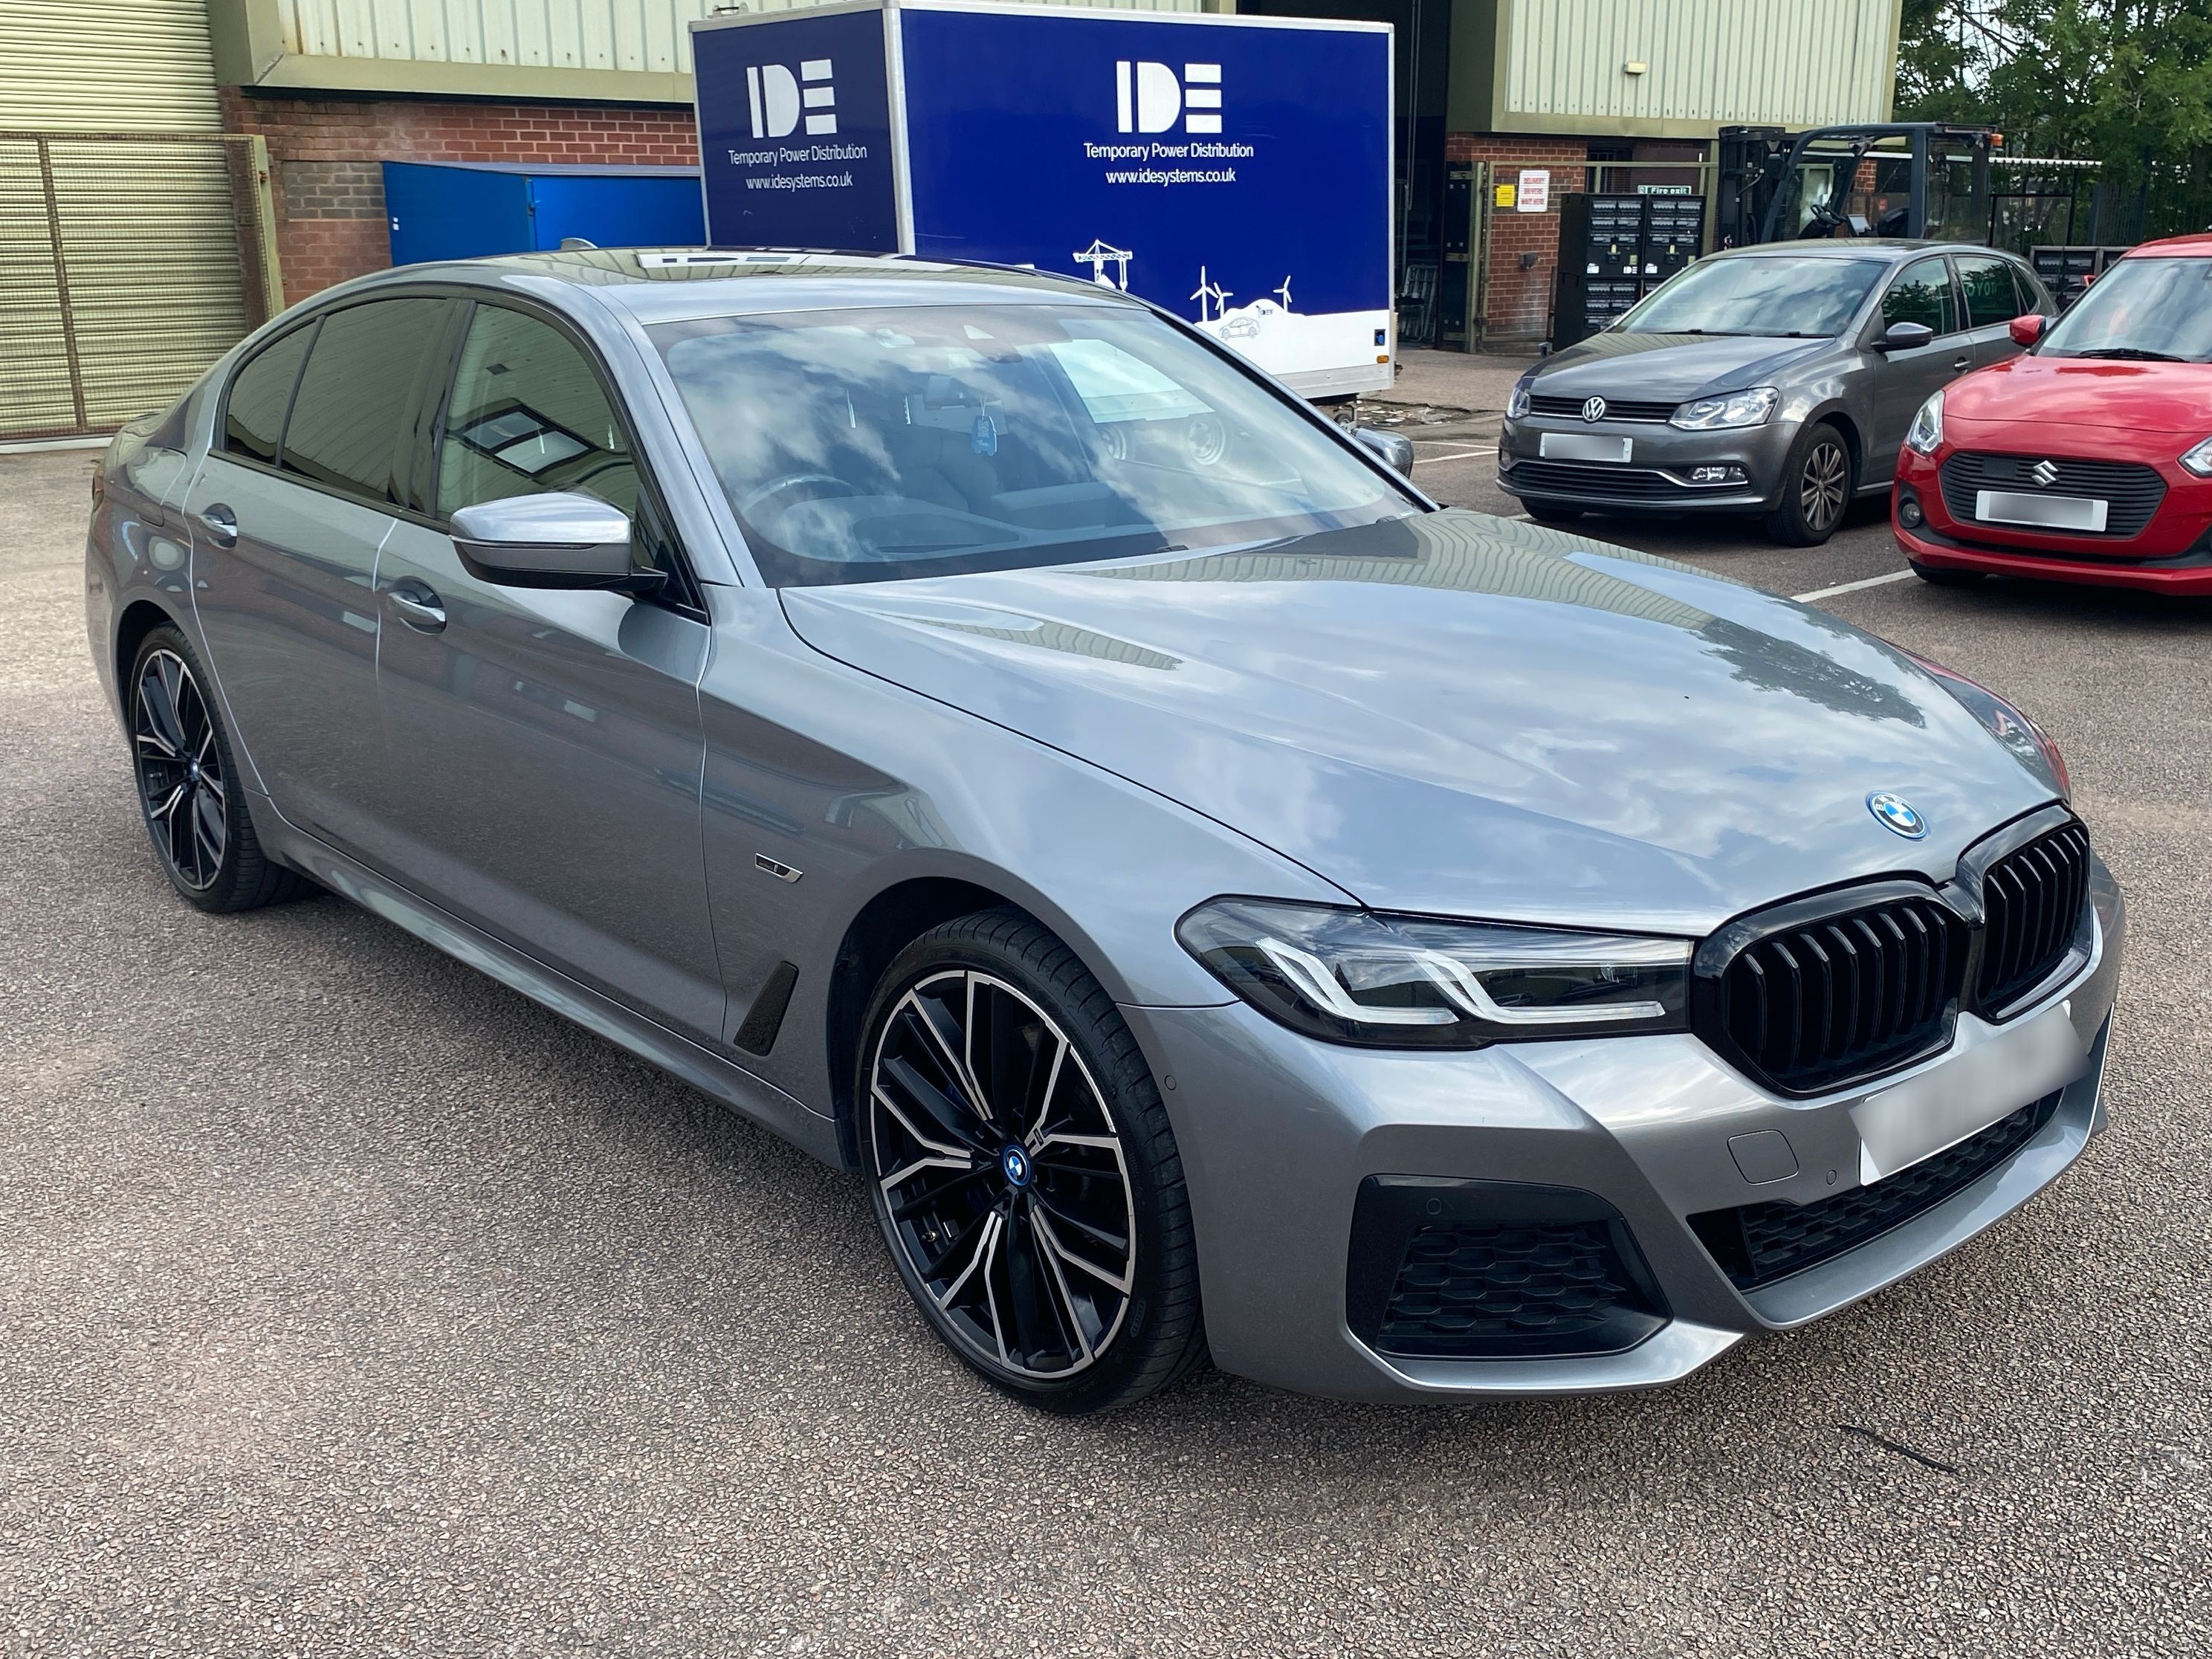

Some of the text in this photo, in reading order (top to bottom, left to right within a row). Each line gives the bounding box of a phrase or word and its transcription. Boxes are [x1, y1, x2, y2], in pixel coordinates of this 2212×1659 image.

[747, 59, 838, 139] IDE
[1116, 61, 1222, 134] IDE
[728, 143, 867, 167] Temporary Power Distribution
[1083, 142, 1254, 161] Temporary Power Distribution
[746, 171, 853, 193] www.idesystems.co.uk
[1105, 167, 1236, 187] www.idesystems.co.uk
